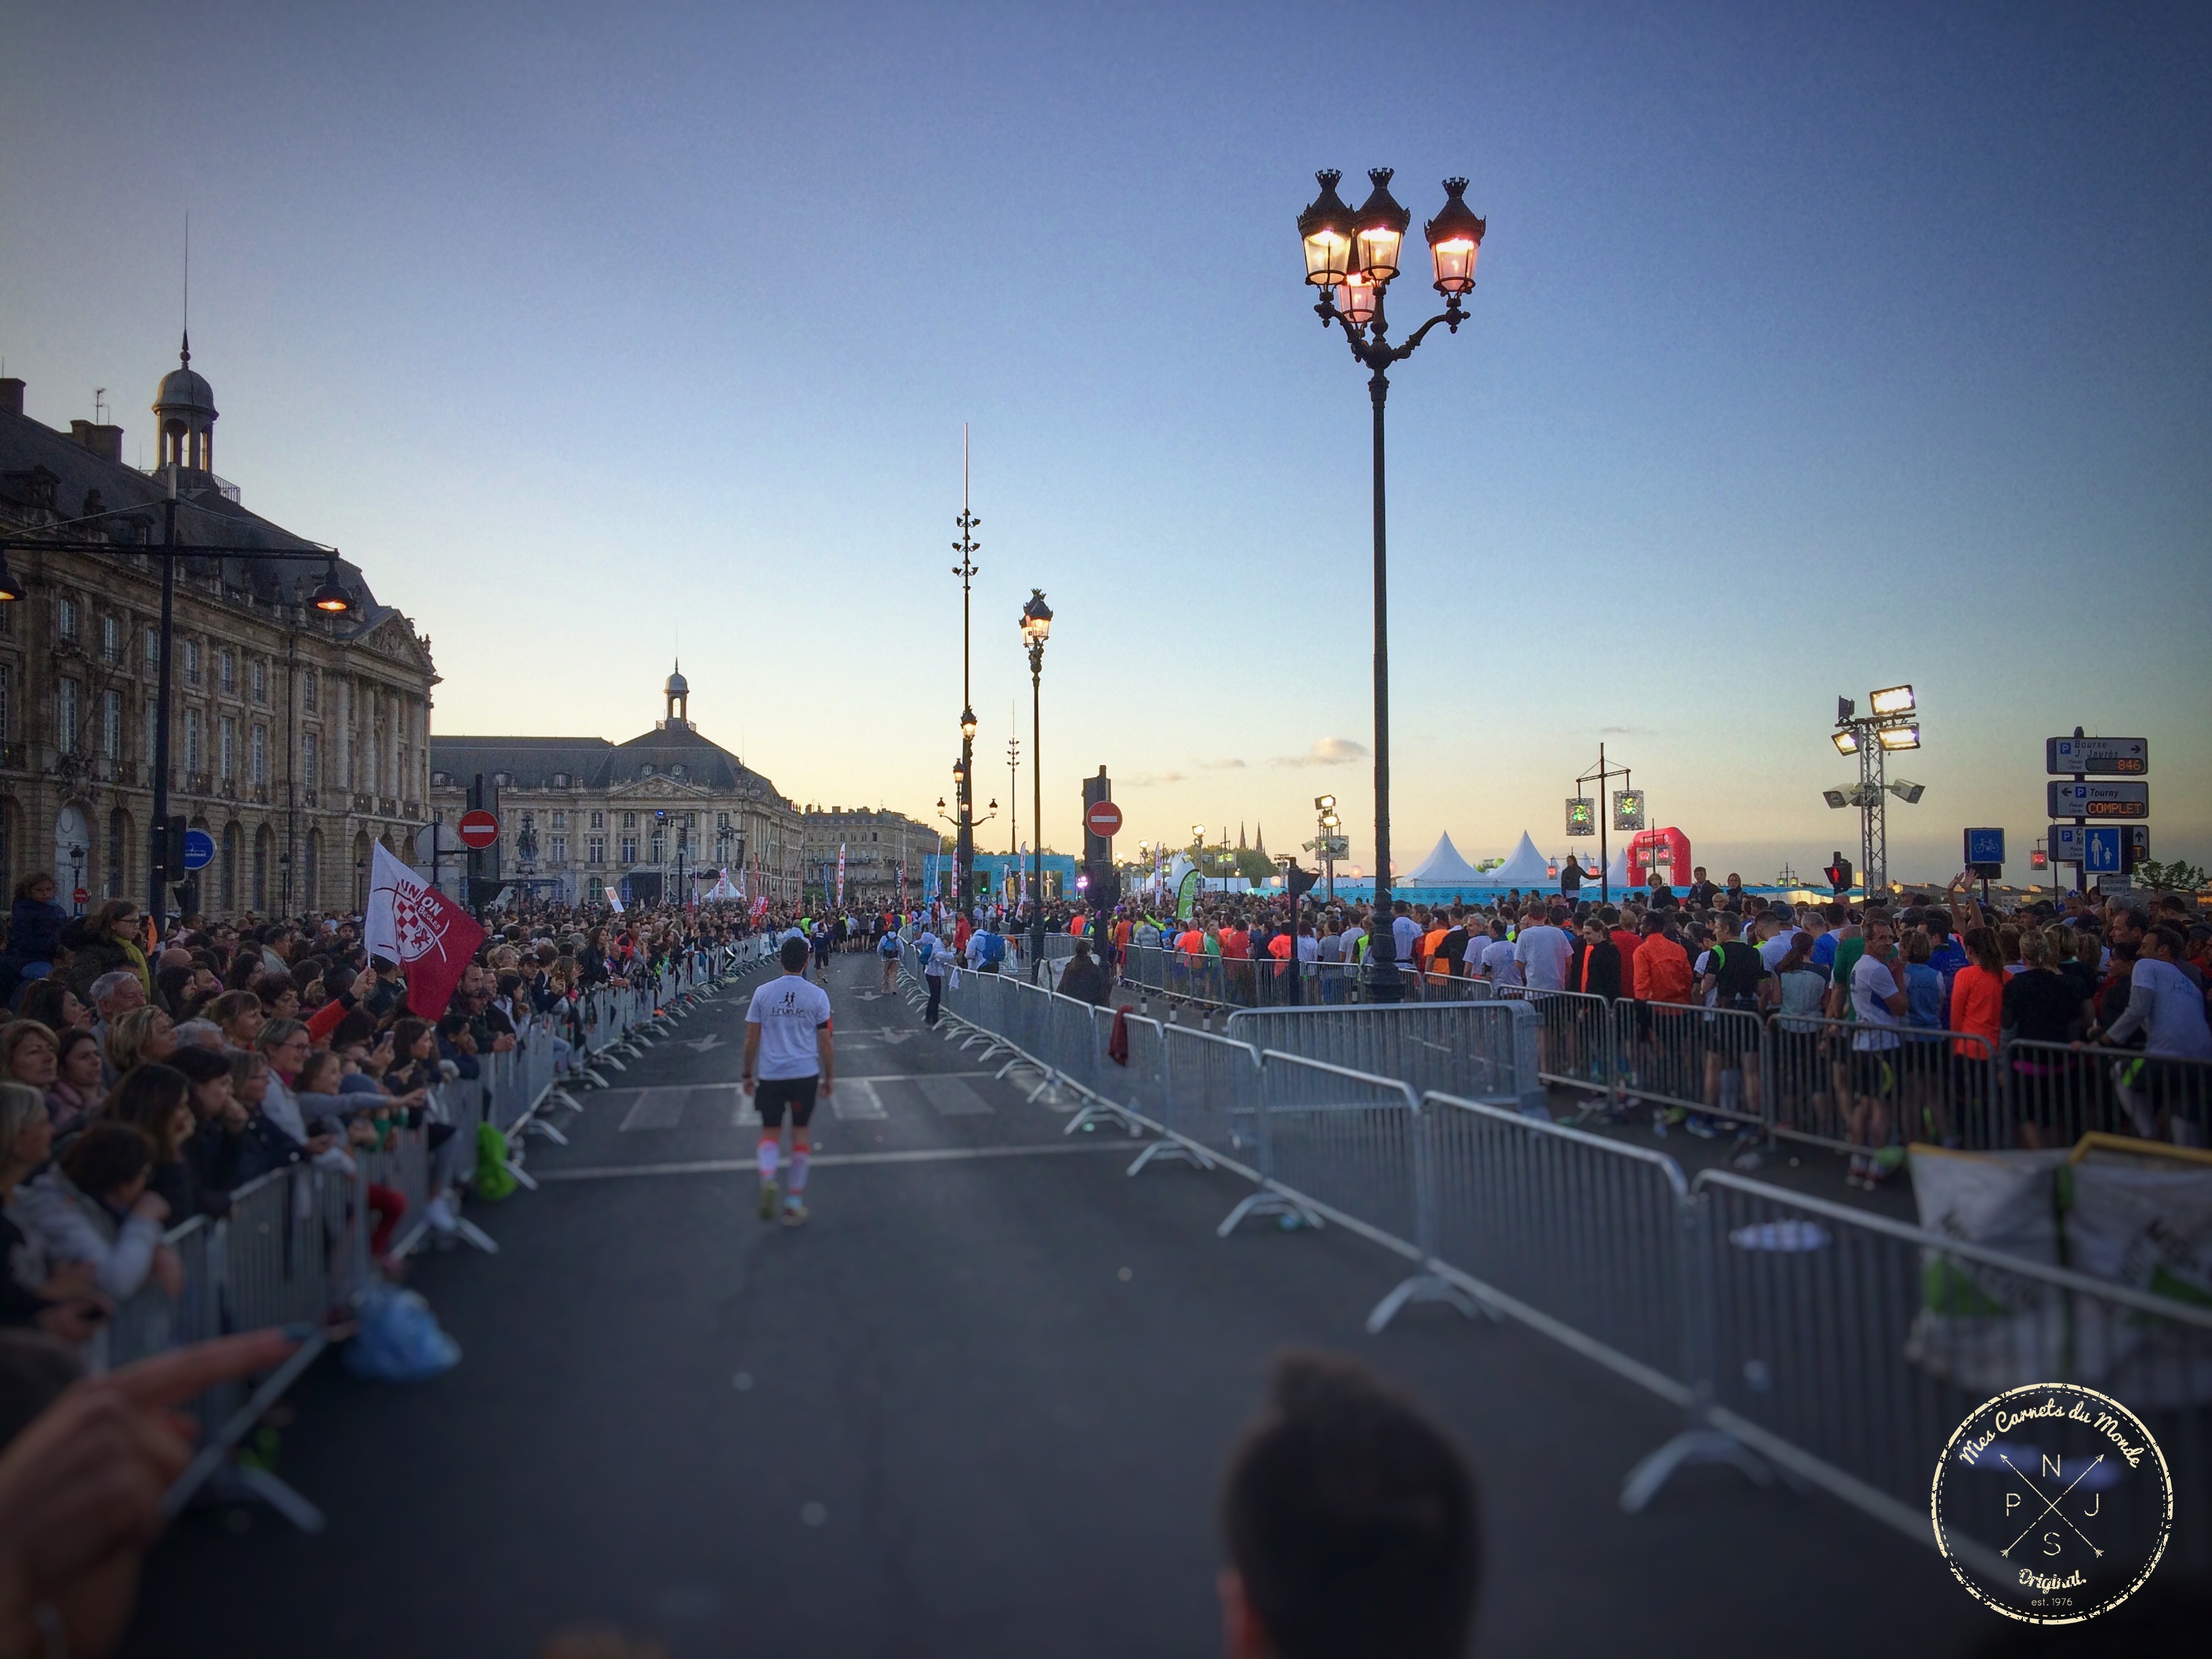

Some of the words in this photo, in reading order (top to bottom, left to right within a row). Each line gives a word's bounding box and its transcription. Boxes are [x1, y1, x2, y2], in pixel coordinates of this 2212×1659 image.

[2074, 740, 2107, 748] Bourse
[2087, 750, 2118, 758] Jaurès
[2118, 760, 2141, 770] 846
[2078, 788, 2084, 797] P
[2090, 788, 2119, 798] Tourny
[2088, 803, 2142, 813] COMPLET
[401, 878, 443, 916] UNION
